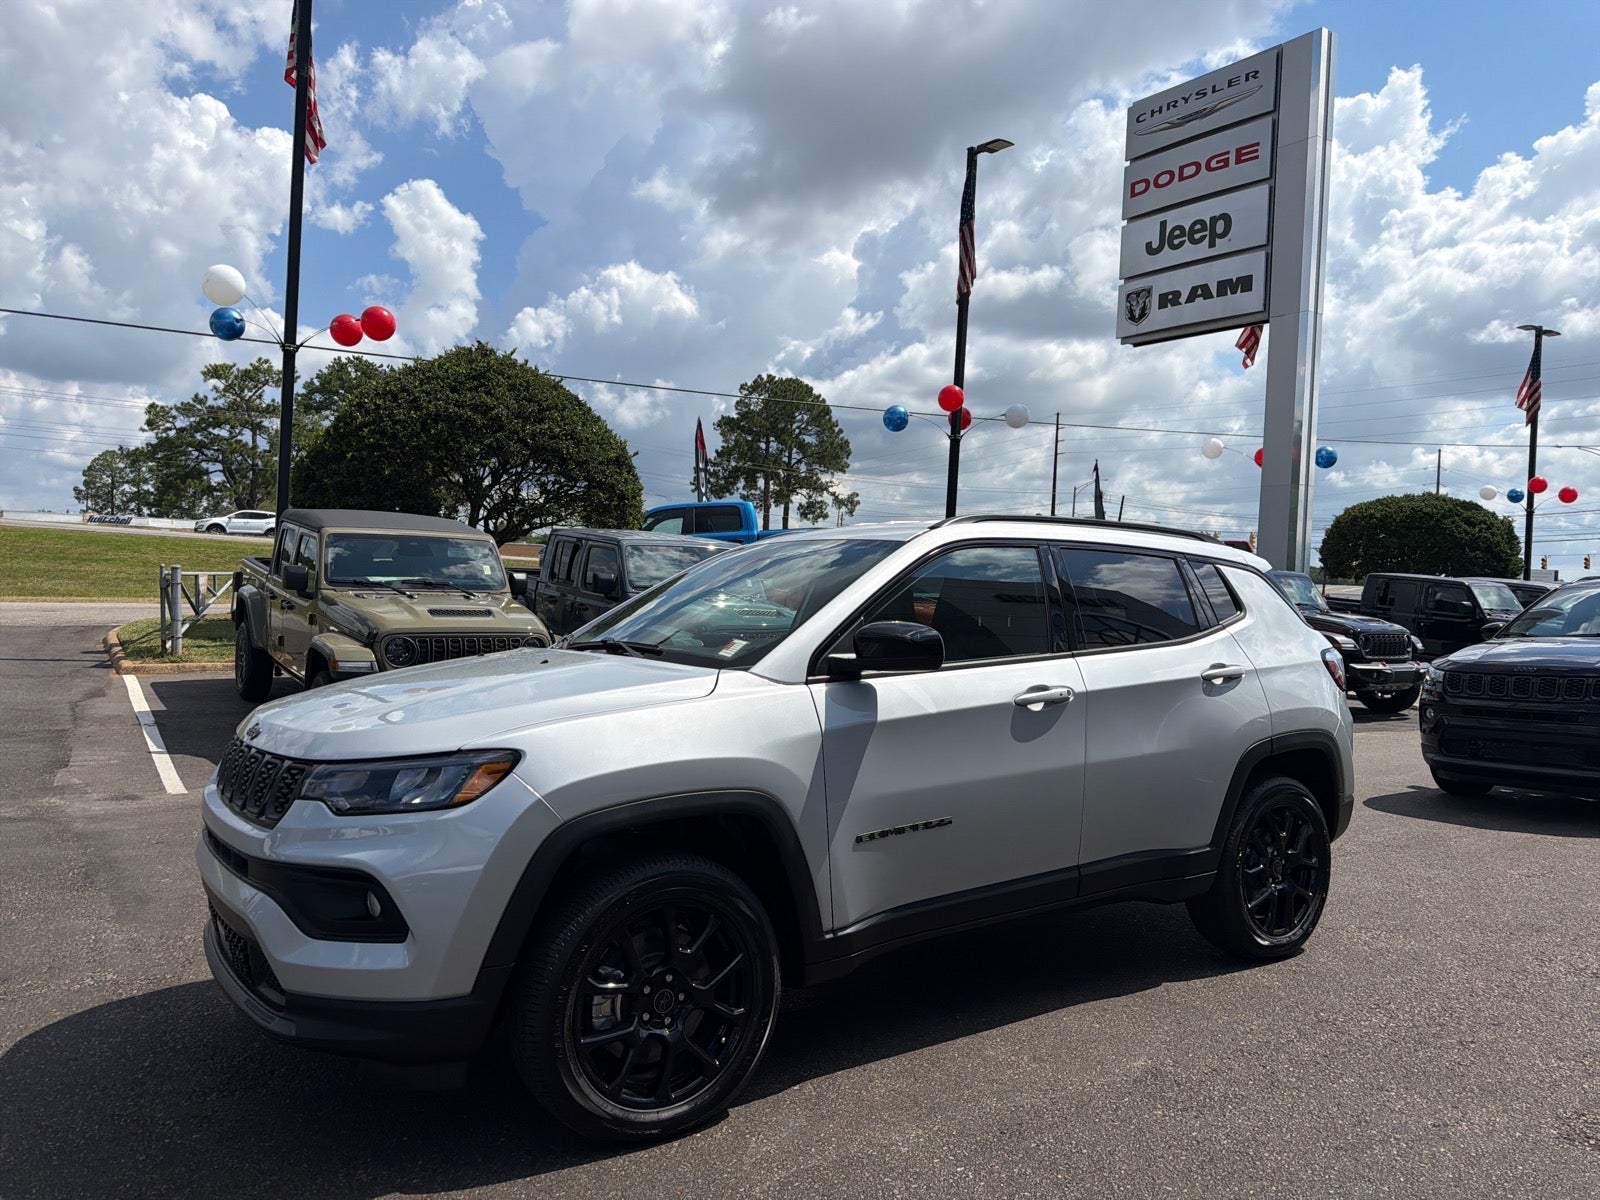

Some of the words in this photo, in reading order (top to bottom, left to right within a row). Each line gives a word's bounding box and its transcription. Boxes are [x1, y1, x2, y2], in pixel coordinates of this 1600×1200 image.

[1135, 70, 1260, 124] CHRYSLER
[1129, 141, 1261, 199] DODGE
[1145, 212, 1233, 256] Jeep
[1157, 274, 1254, 313] RAM
